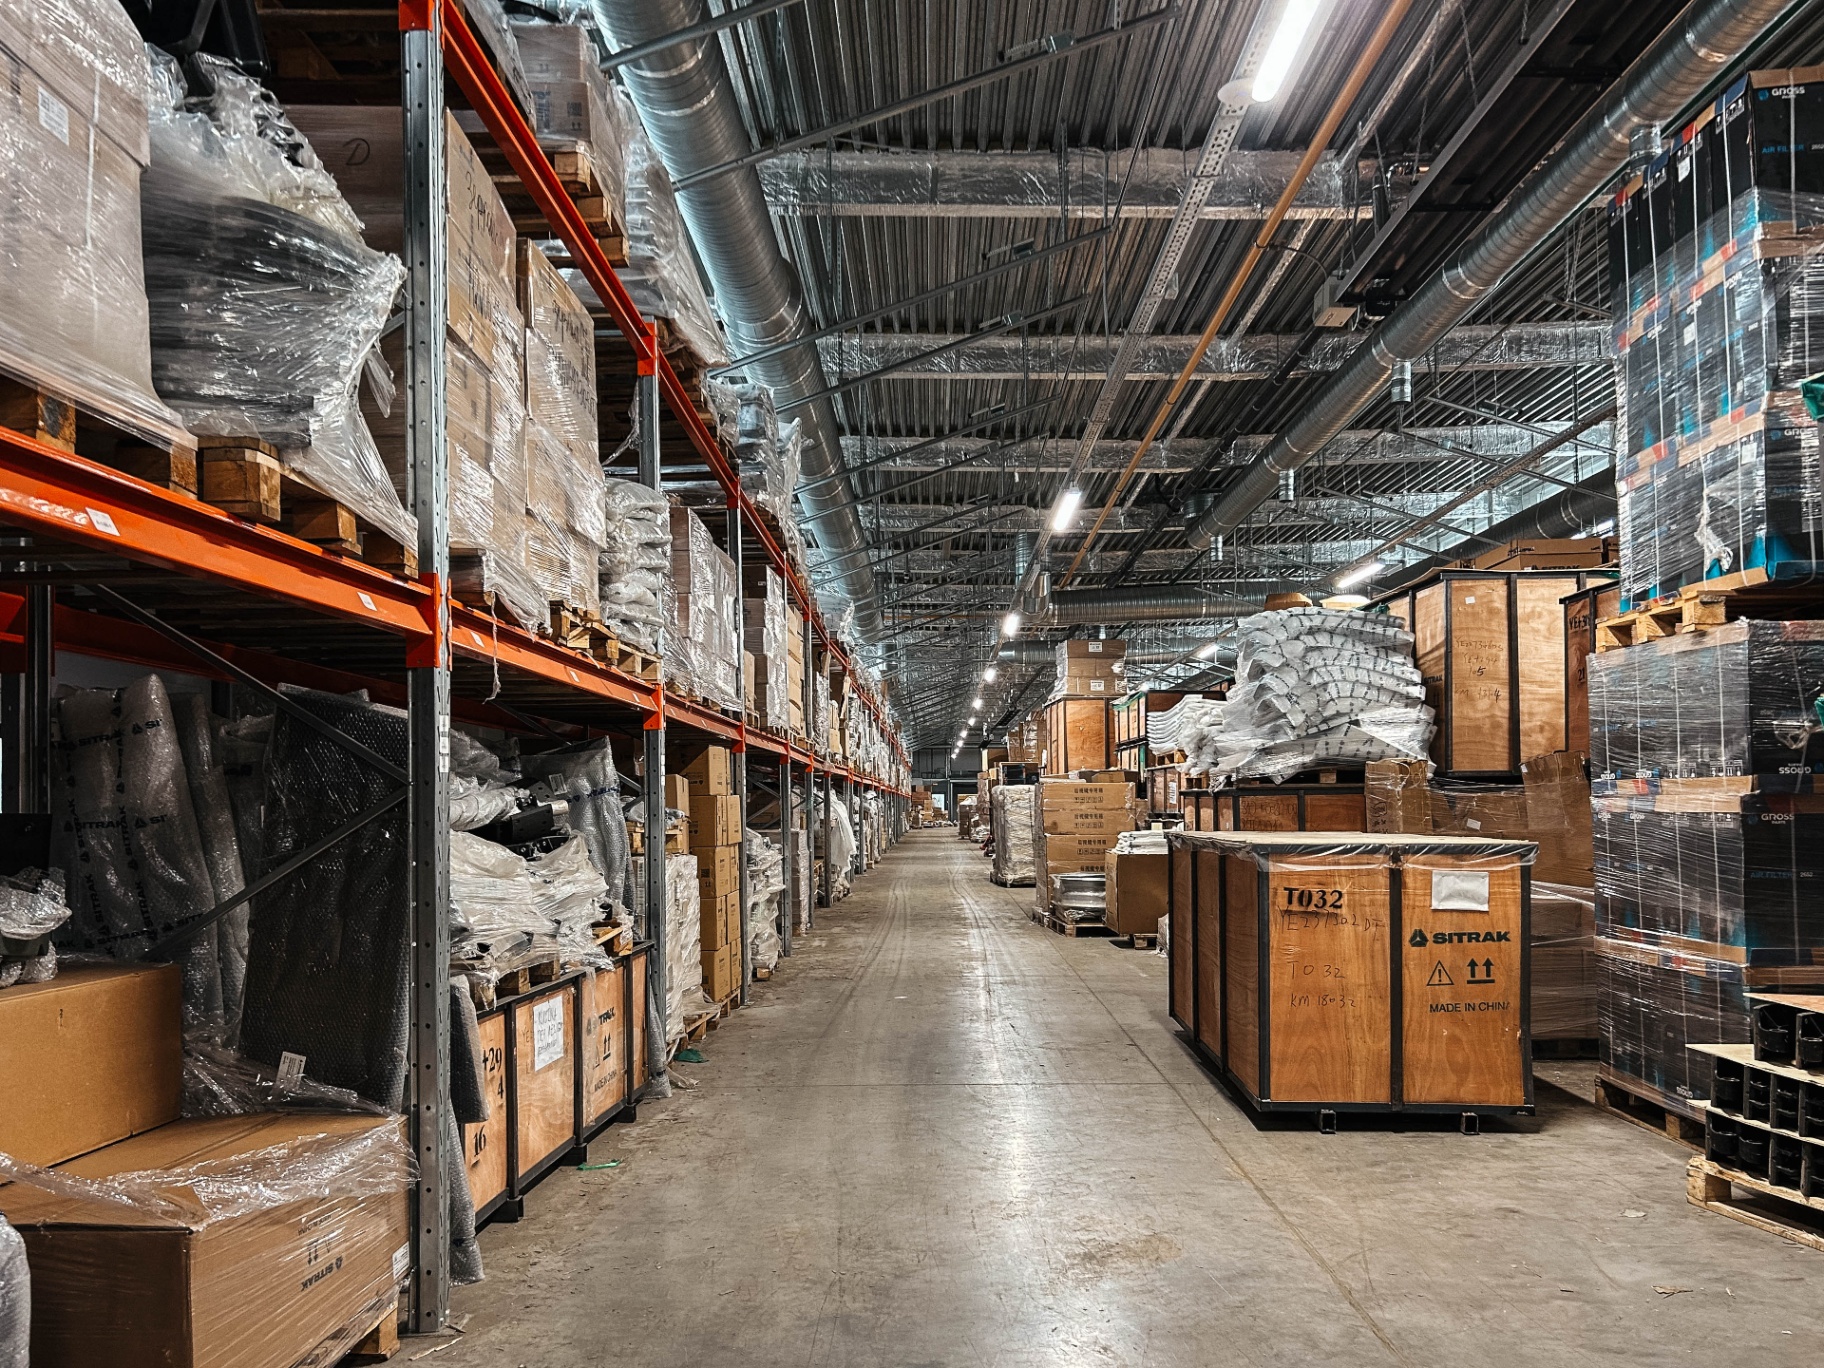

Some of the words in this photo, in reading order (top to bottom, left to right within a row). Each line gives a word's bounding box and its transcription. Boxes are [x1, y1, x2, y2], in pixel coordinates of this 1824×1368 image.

[342, 137, 370, 166] D
[1778, 766, 1812, 774] GROSS
[1761, 813, 1795, 821] GROSS
[1432, 931, 1511, 945] SITRAK
[1429, 1003, 1461, 1013] MADE
[1464, 1002, 1476, 1012] IN
[473, 1124, 487, 1159] 16
[301, 1262, 334, 1292] SITRAK
